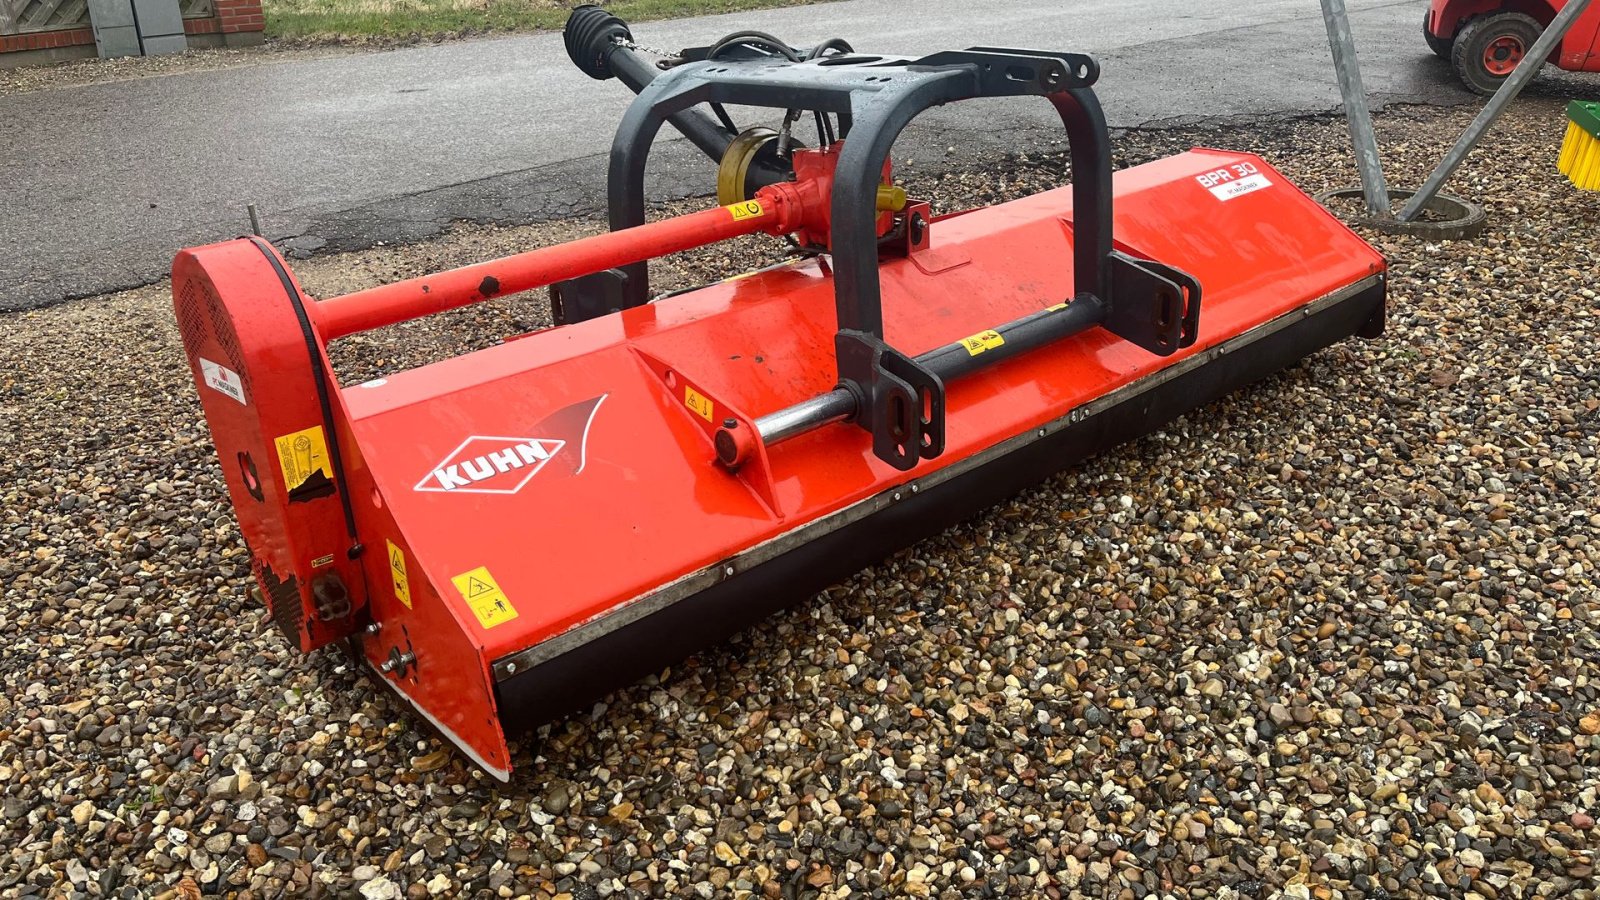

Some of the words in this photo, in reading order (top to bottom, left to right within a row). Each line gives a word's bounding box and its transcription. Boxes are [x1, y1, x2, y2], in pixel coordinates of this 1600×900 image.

[1195, 169, 1234, 188] BPR
[1231, 162, 1258, 176] 30
[432, 440, 550, 491] KUHN
